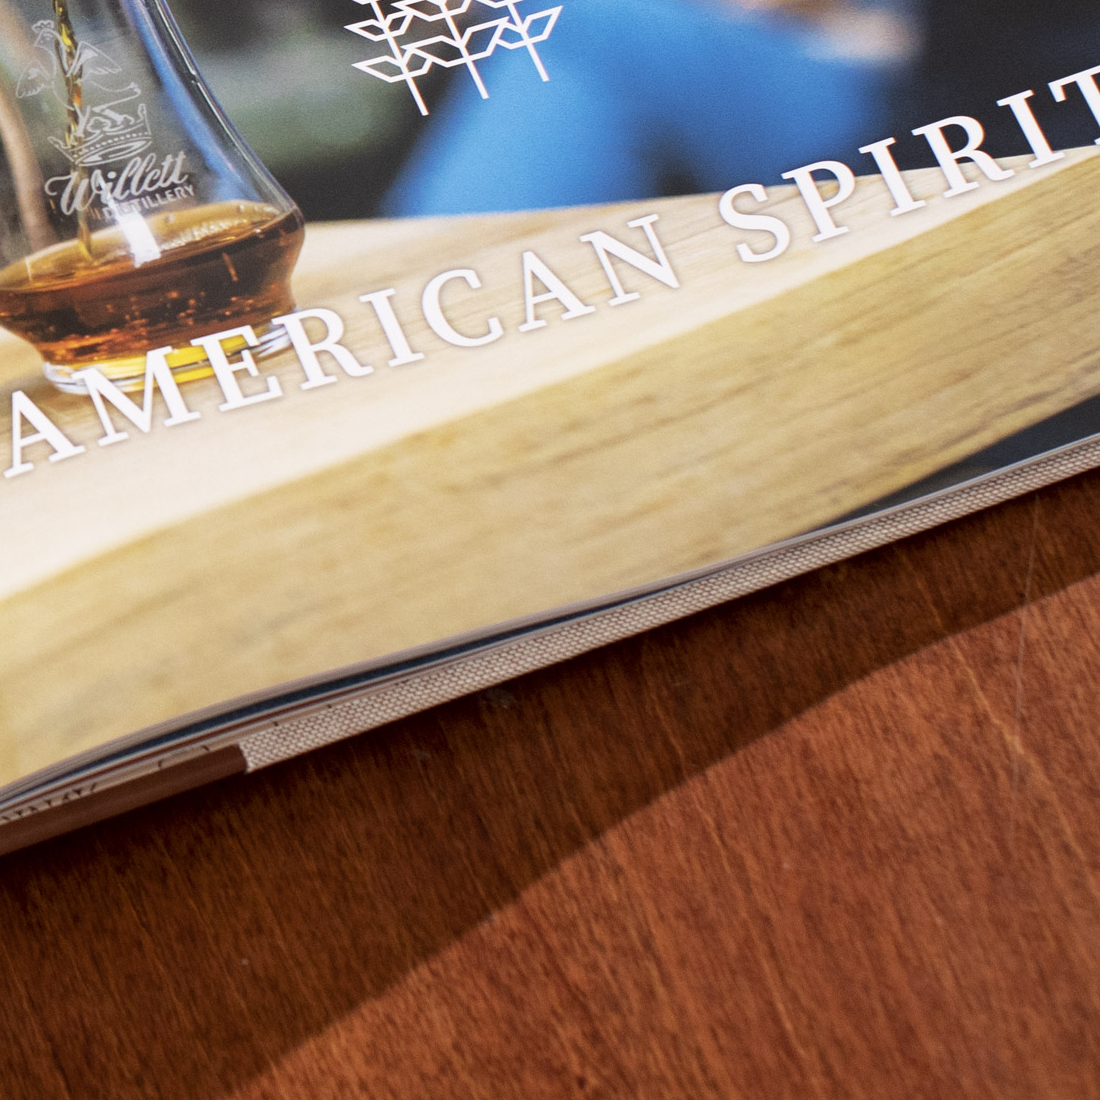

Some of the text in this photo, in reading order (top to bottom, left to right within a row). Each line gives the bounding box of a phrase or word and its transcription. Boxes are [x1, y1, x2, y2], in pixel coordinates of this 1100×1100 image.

[44, 151, 189, 216] Willett
[102, 184, 195, 221] DISTILLERY
[4, 214, 681, 479] AMERICAN
